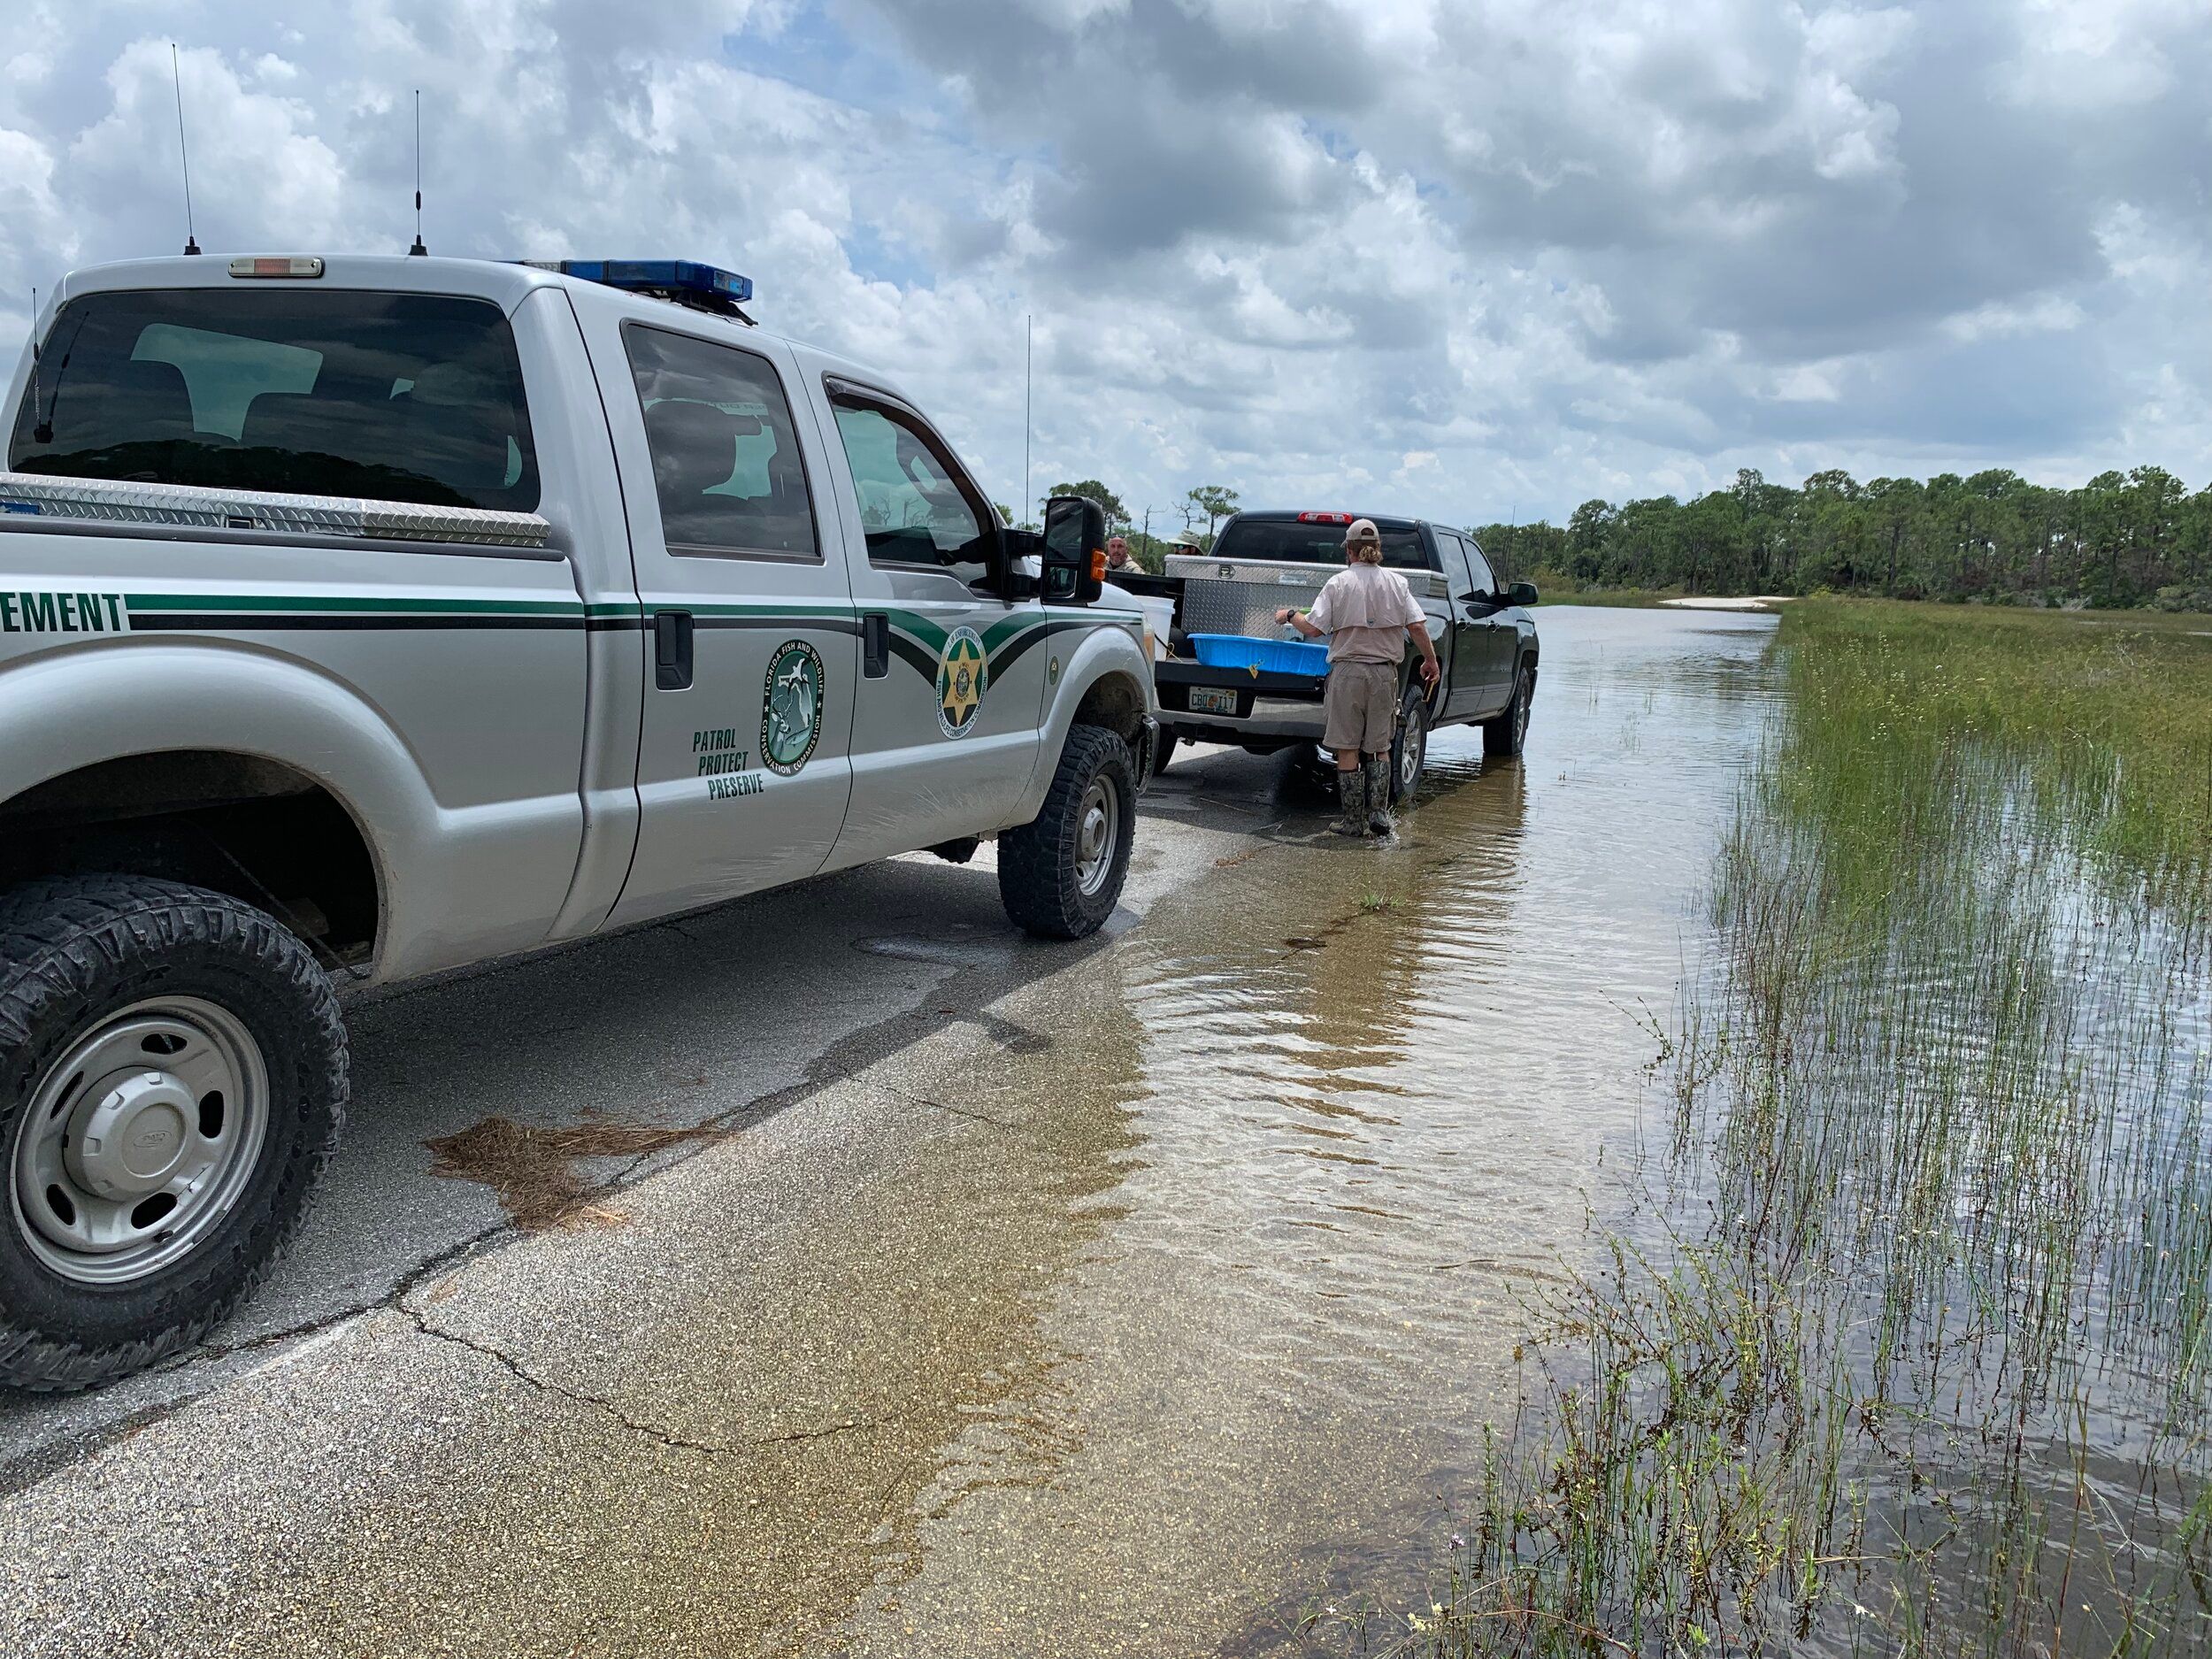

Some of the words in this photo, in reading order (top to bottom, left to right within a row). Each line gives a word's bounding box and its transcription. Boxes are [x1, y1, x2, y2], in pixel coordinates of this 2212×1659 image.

[0, 592, 121, 632] EMENT
[764, 653, 781, 695] FLORIDA
[781, 641, 795, 655] FISH
[796, 641, 810, 653] AND
[810, 649, 824, 695] WILDLIFE
[693, 728, 736, 752] PATROL
[761, 718, 791, 774] CONSERVATION
[793, 715, 821, 772] COMMISSION
[698, 751, 749, 776] PROTECT
[707, 773, 764, 800] PRESERVE
